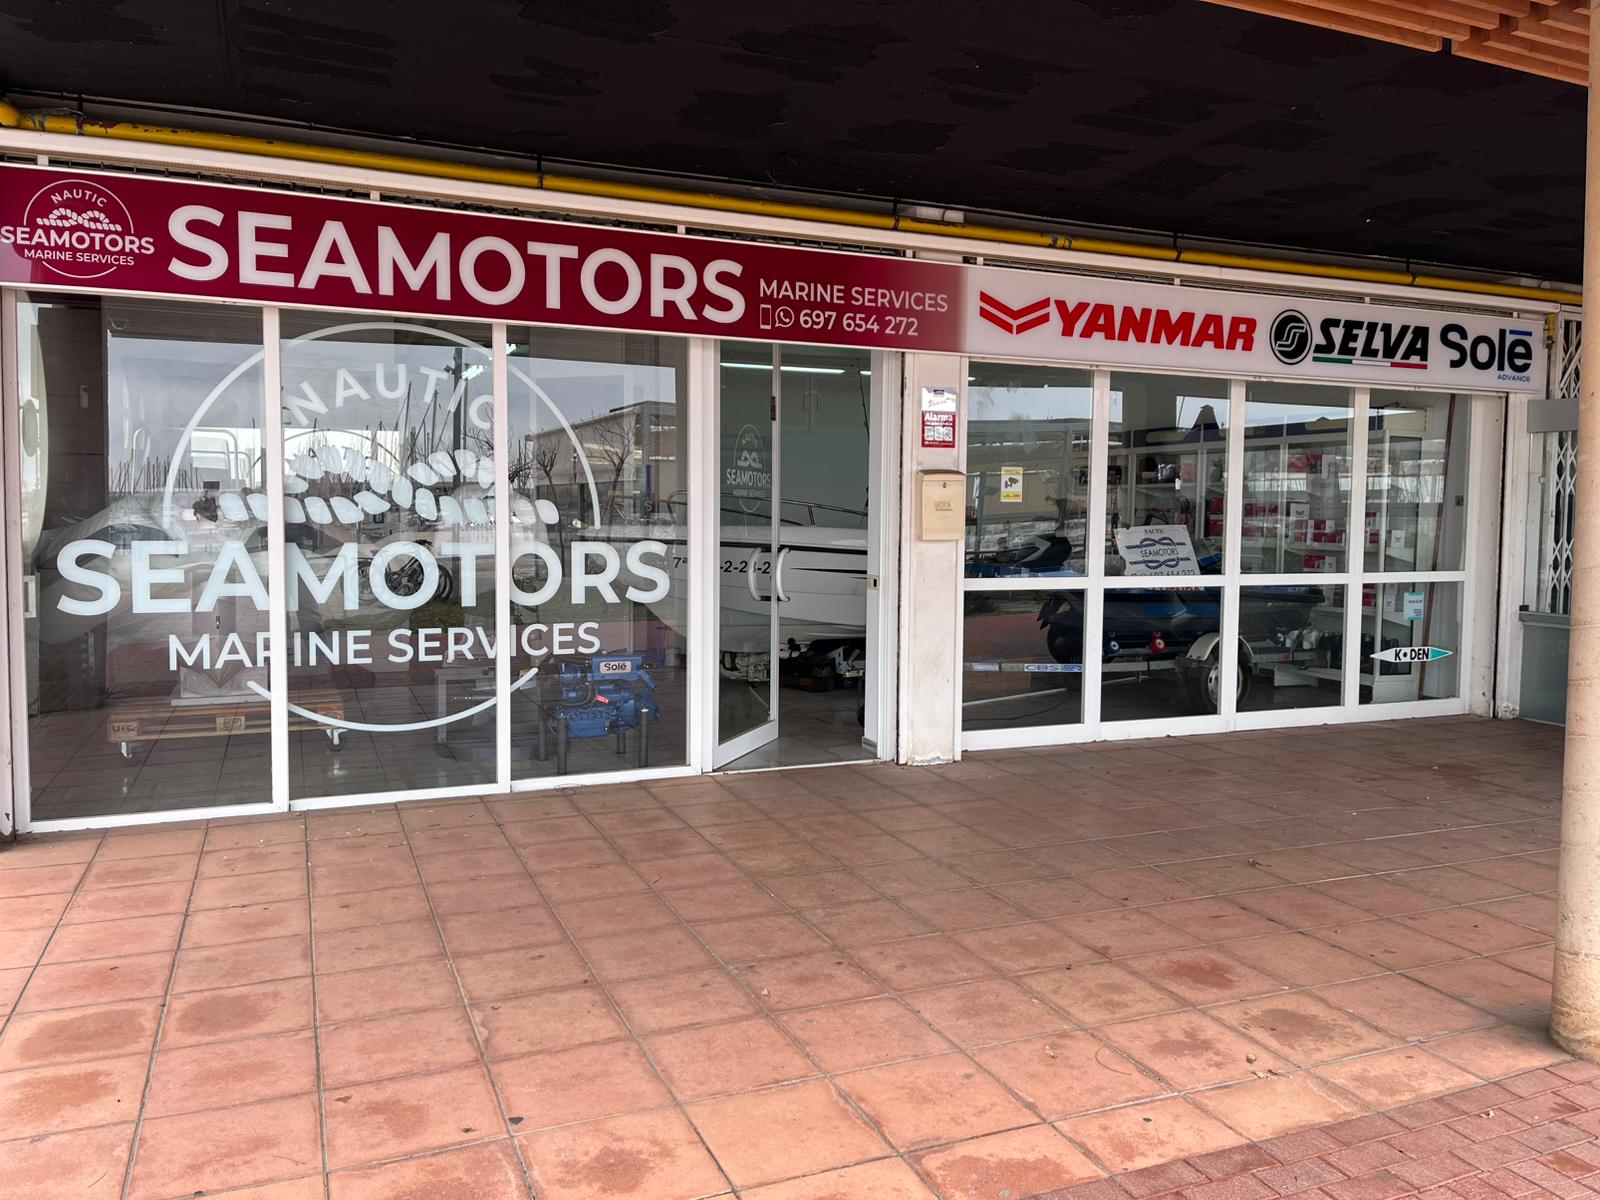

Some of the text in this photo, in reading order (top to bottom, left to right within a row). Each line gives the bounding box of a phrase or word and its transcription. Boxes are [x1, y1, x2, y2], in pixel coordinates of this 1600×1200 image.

[51, 189, 107, 207] NAUTIC
[0, 225, 155, 255] SEAMOTORS
[24, 249, 135, 266] MARINE SERVICES
[167, 204, 746, 325] SEAMOTORS
[759, 278, 948, 312] MARINE SERVICES
[799, 309, 919, 336] 697 654 272
[1054, 299, 1257, 352] YANMAR
[1314, 317, 1430, 362] SELVA
[1497, 374, 1531, 382] ADVANCE
[284, 362, 494, 430] NAUTIC
[726, 468, 771, 487] SEAMOTORS
[56, 539, 671, 616] SEAMOTORS
[388, 621, 601, 663] SERVICES
